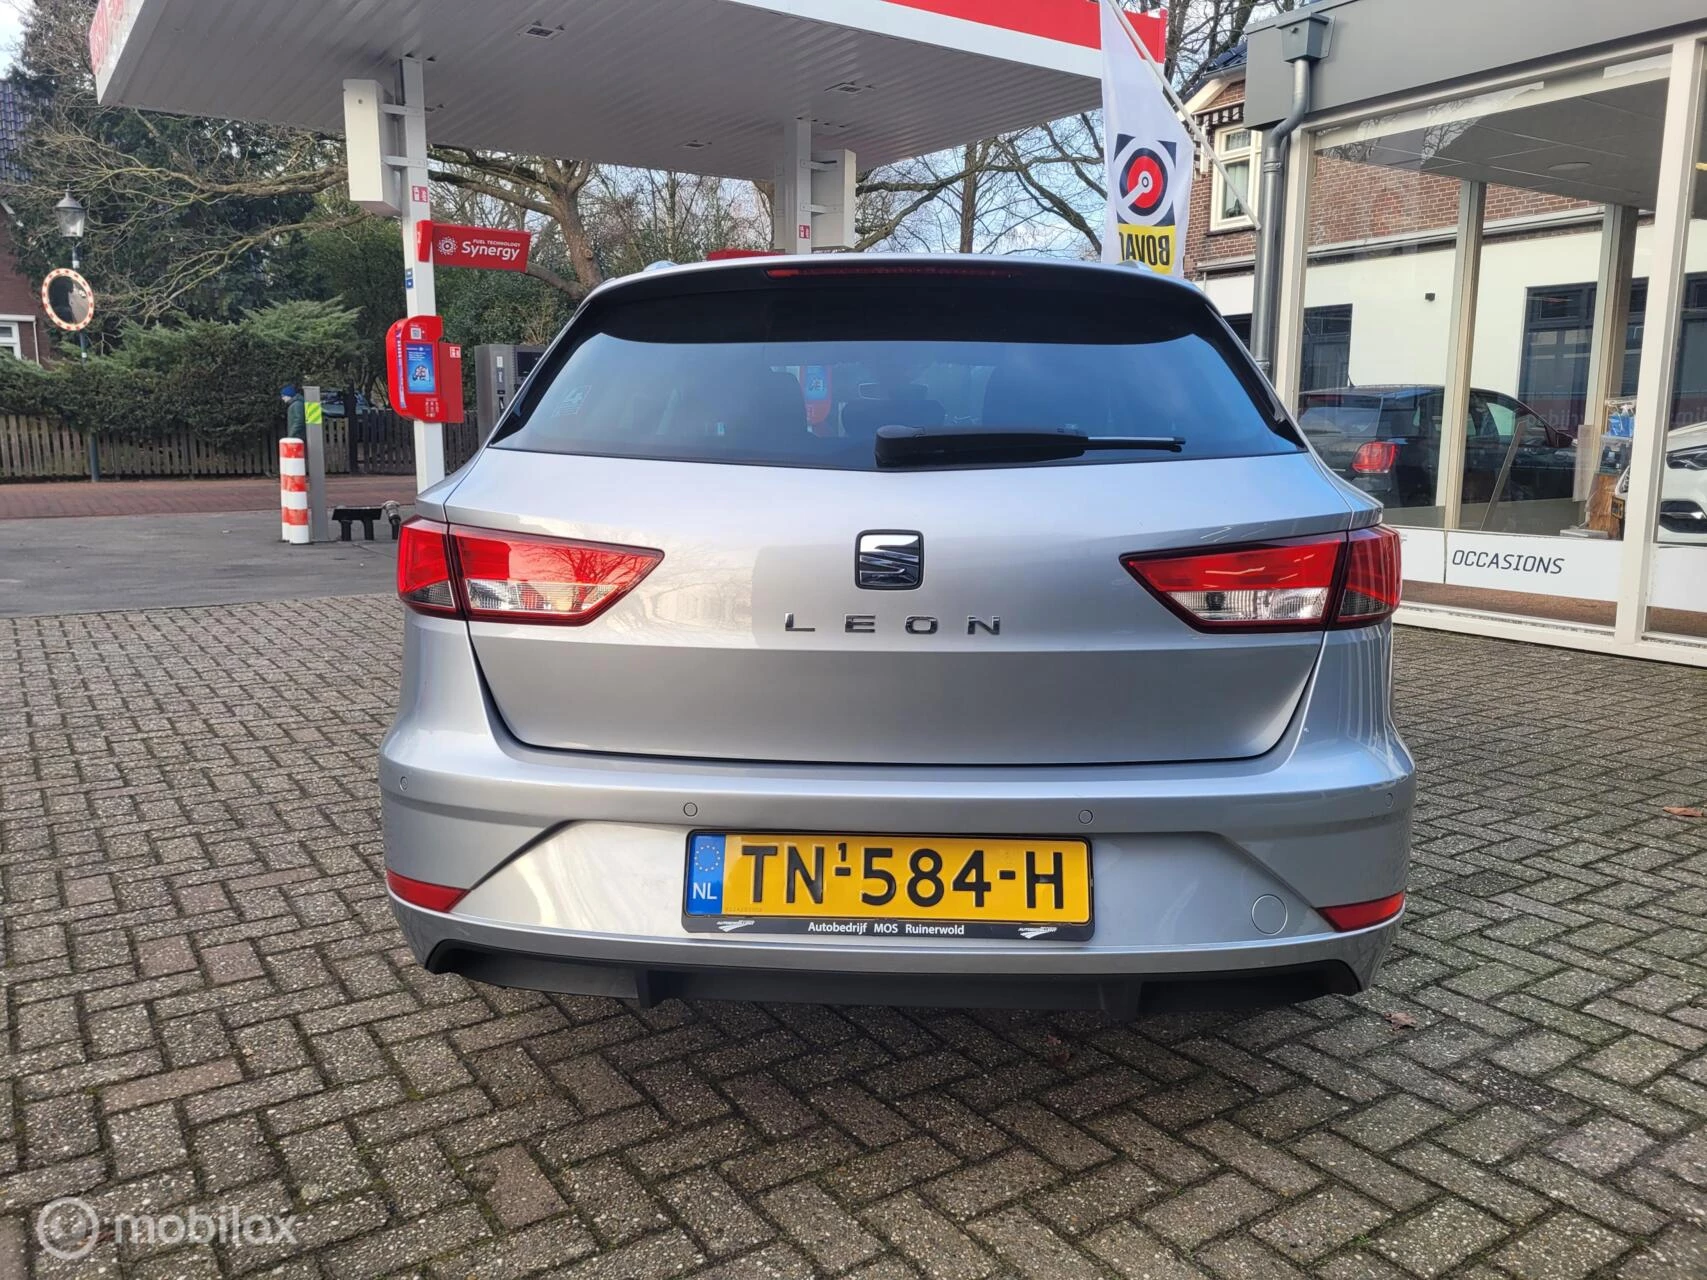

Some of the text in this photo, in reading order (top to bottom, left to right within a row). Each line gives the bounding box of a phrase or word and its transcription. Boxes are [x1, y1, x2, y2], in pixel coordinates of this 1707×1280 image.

[461, 241, 520, 261] Synergy
[487, 240, 521, 248] TECHNOLOGY
[1452, 549, 1565, 575] OCCASIONS
[784, 612, 1001, 636] LEON
[692, 882, 718, 900] NL
[807, 921, 965, 936] Autobedrijf MOS Ruinerwold
